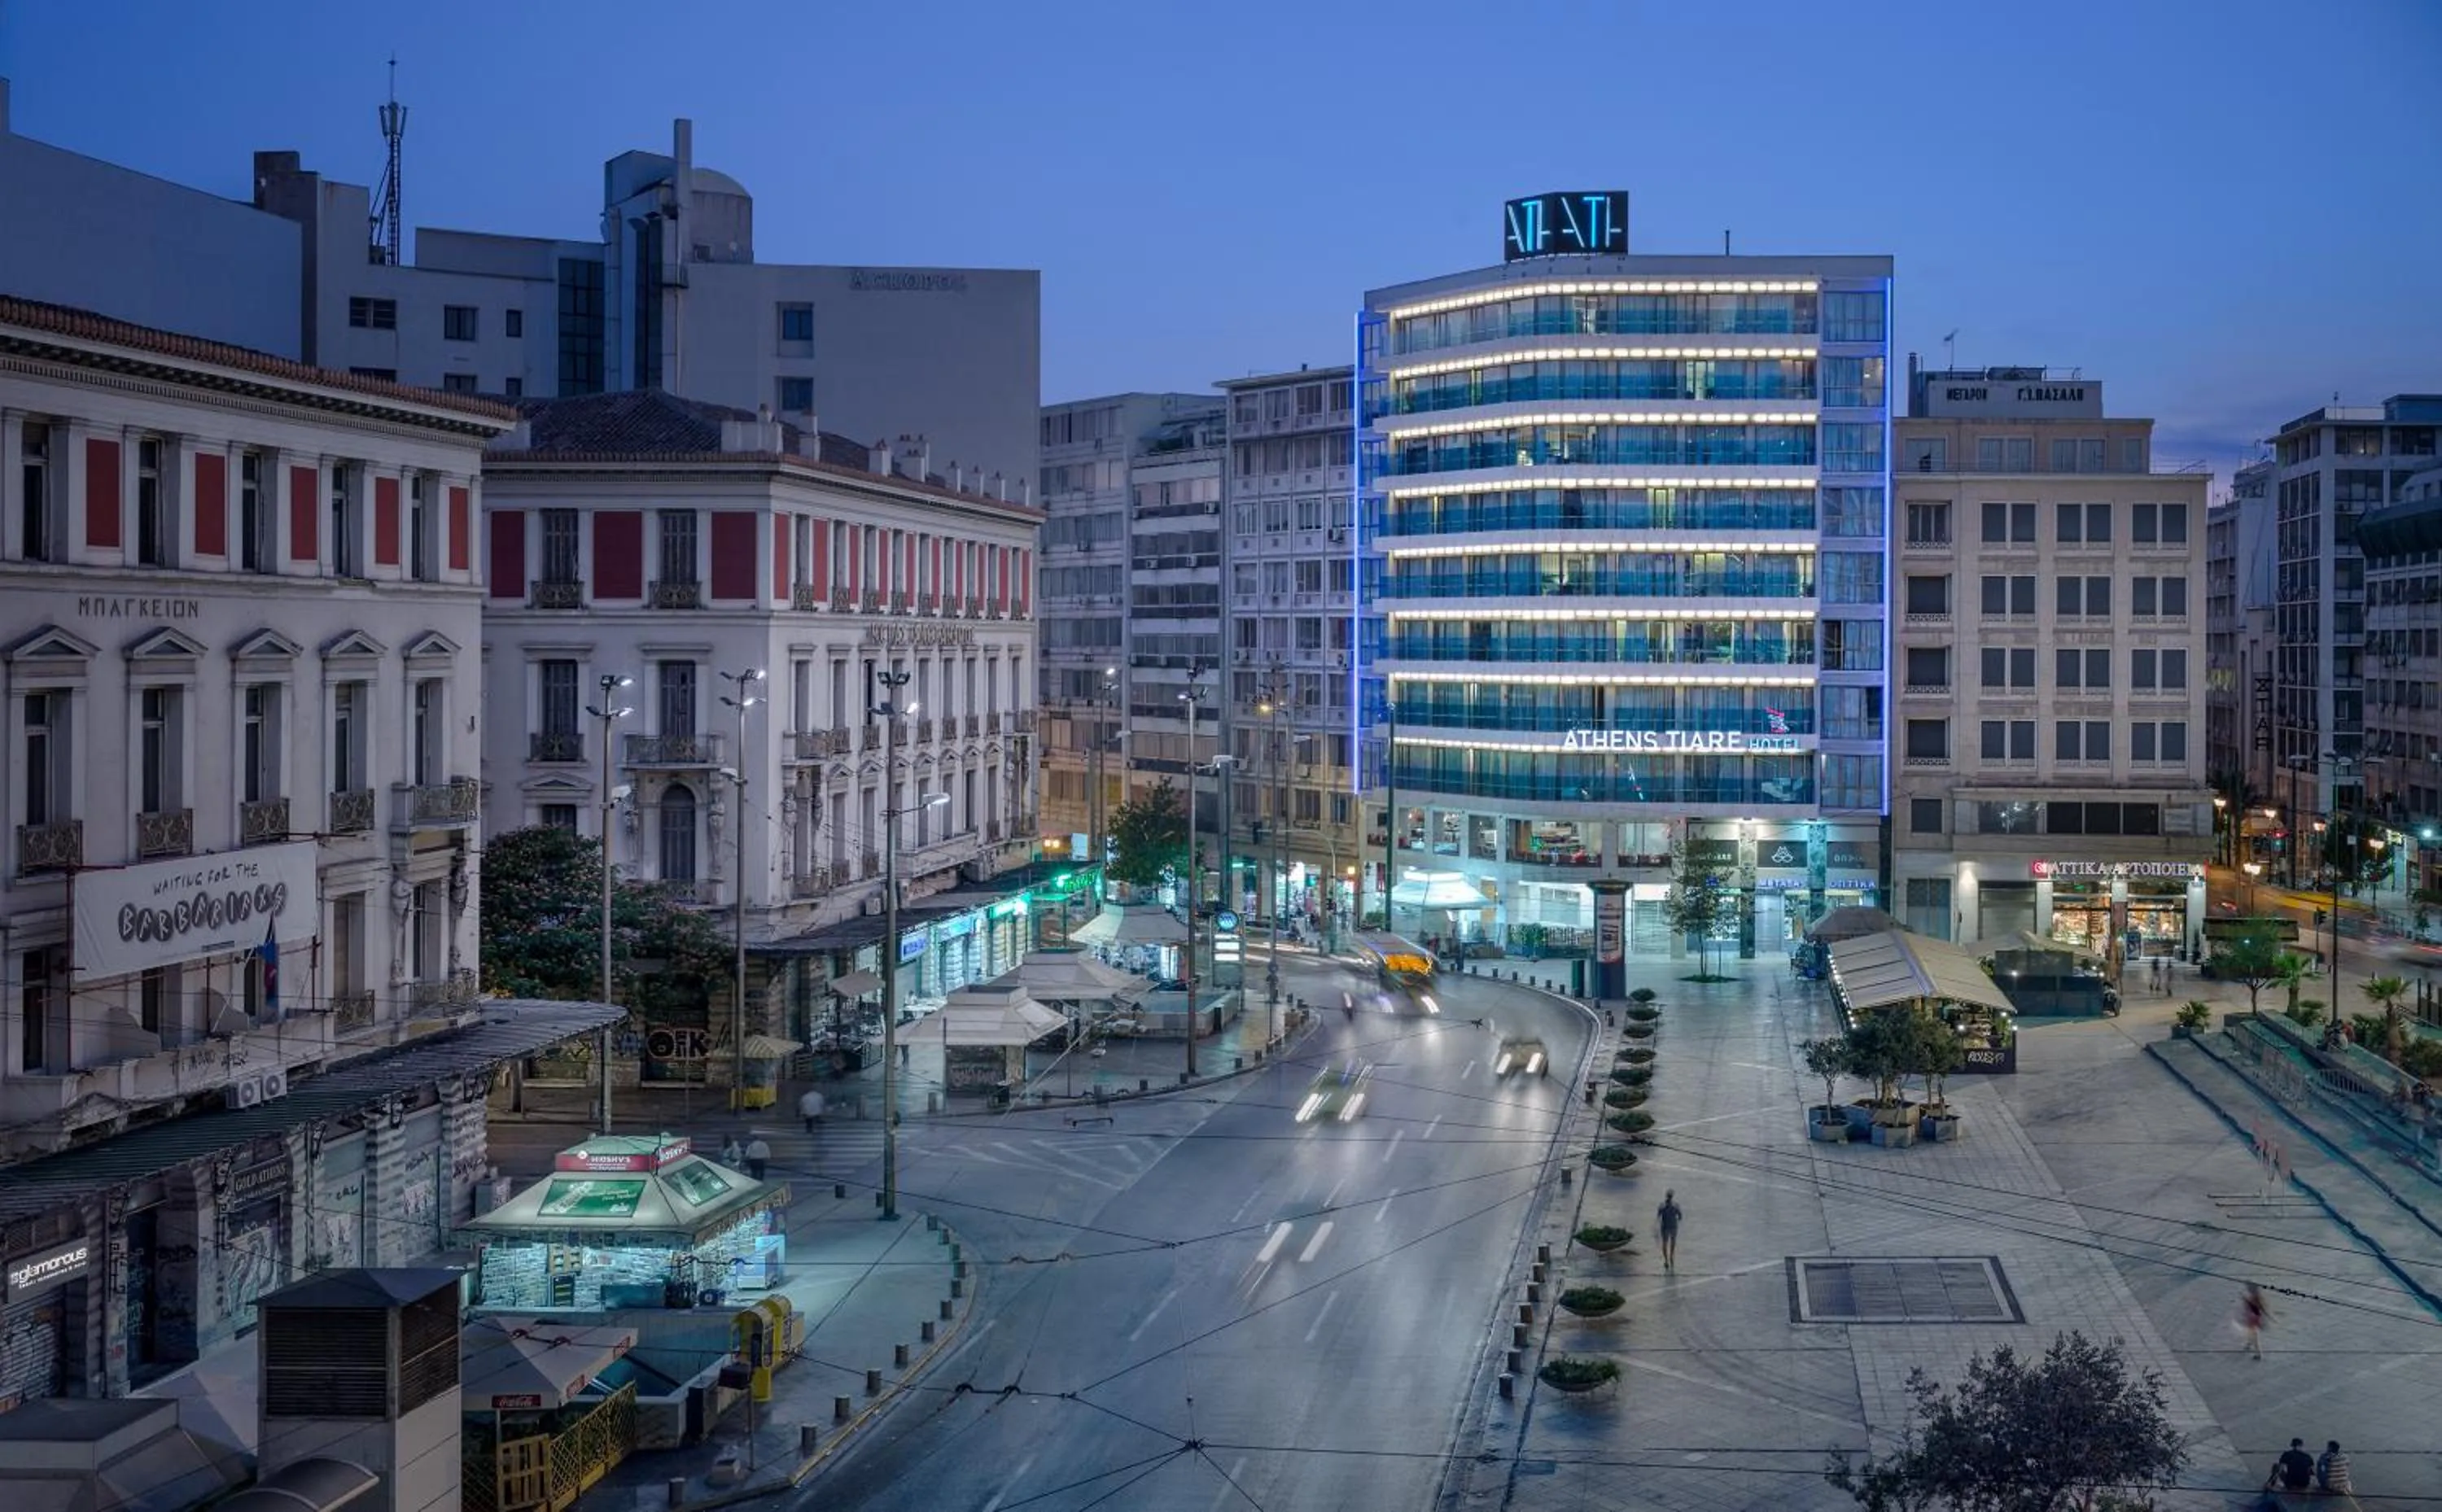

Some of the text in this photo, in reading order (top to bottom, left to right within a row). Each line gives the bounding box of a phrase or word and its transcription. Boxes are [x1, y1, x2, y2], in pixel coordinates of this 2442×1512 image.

[79, 596, 199, 618] ΜΠΑΓΚΕΙΟΝ
[1563, 729, 1800, 750] ATHENS TIARE HOTEL
[153, 863, 259, 895] WAITING FOR THE
[19, 1247, 87, 1284] glamorous
